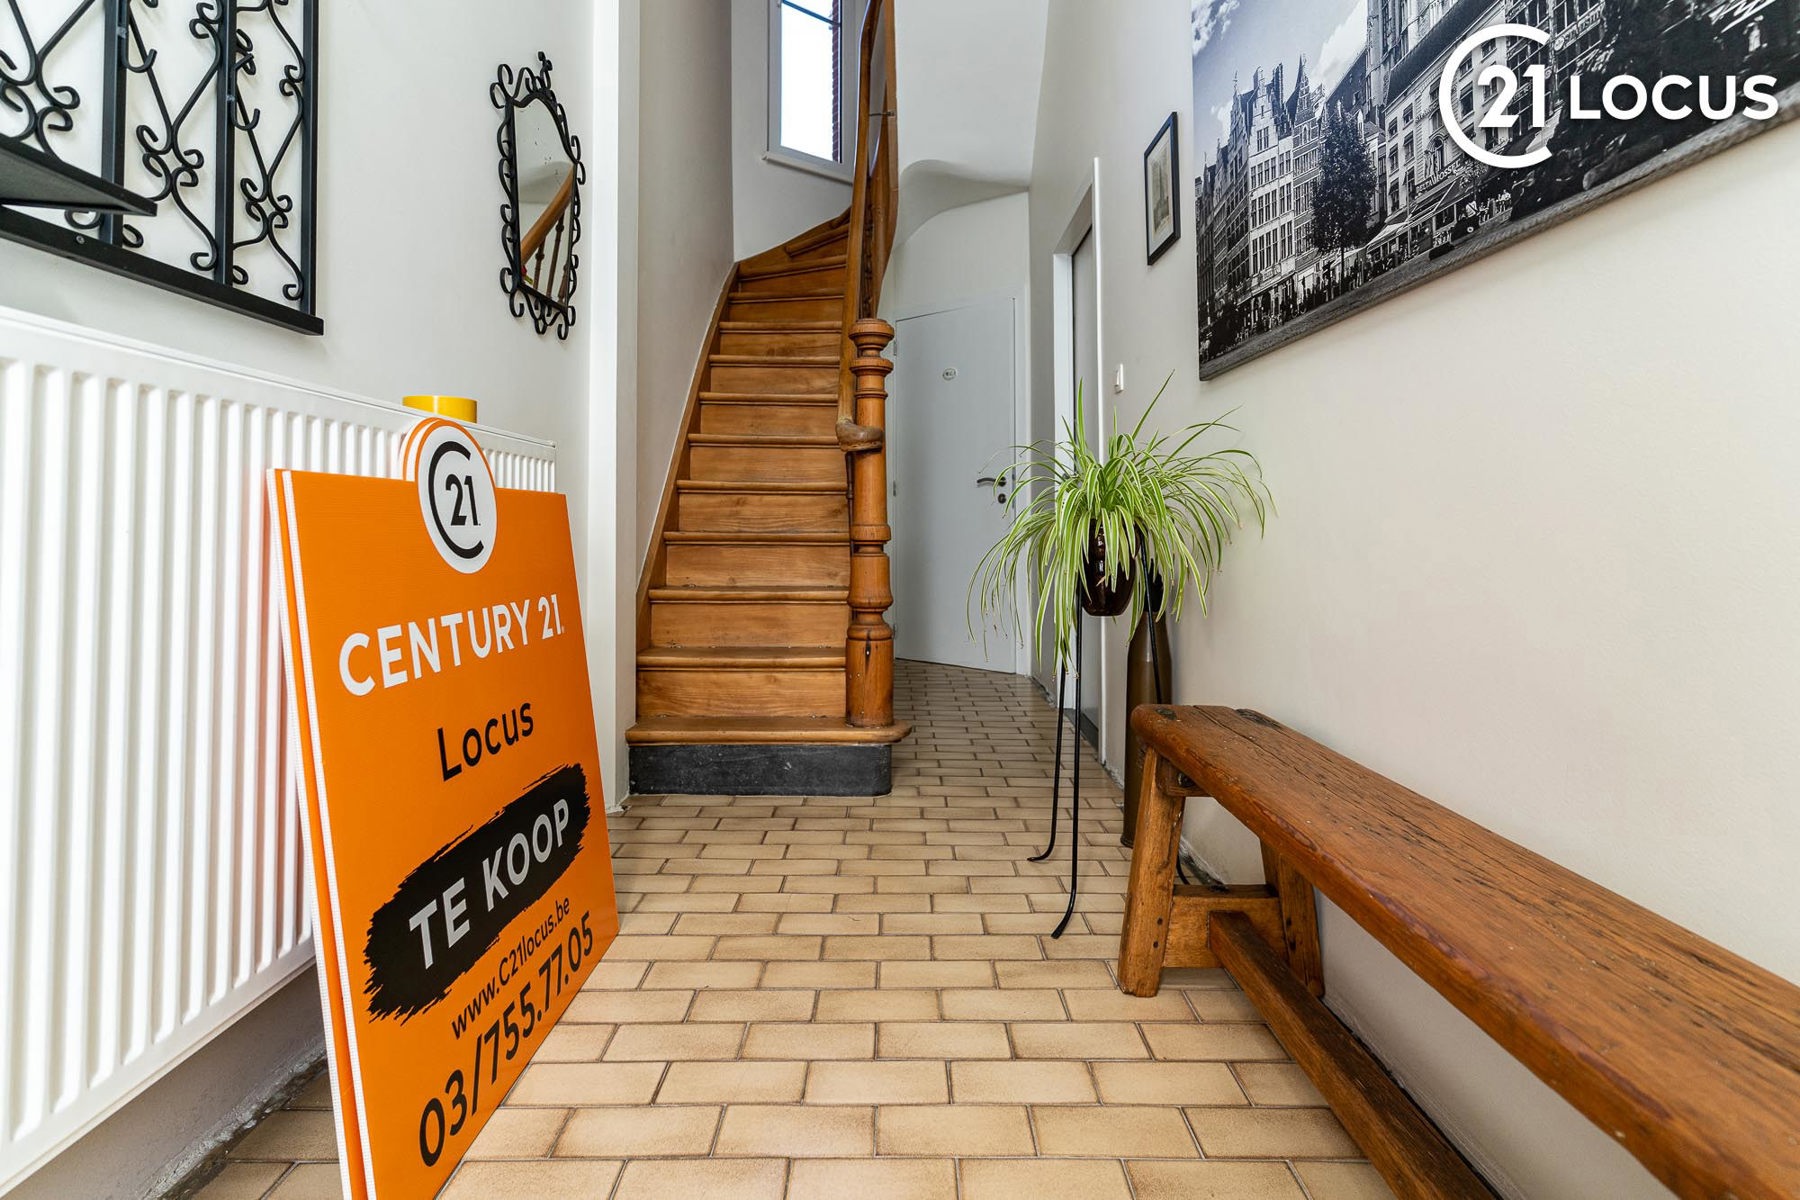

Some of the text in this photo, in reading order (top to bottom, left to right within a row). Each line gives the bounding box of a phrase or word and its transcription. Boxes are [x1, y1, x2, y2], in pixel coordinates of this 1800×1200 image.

[338, 599, 531, 697] CENTURY
[436, 701, 535, 782] Locus
[408, 797, 570, 970] TE KOOP
[418, 910, 594, 1168] 03/755.77.05
[451, 897, 570, 1040] www.C21locus.be
